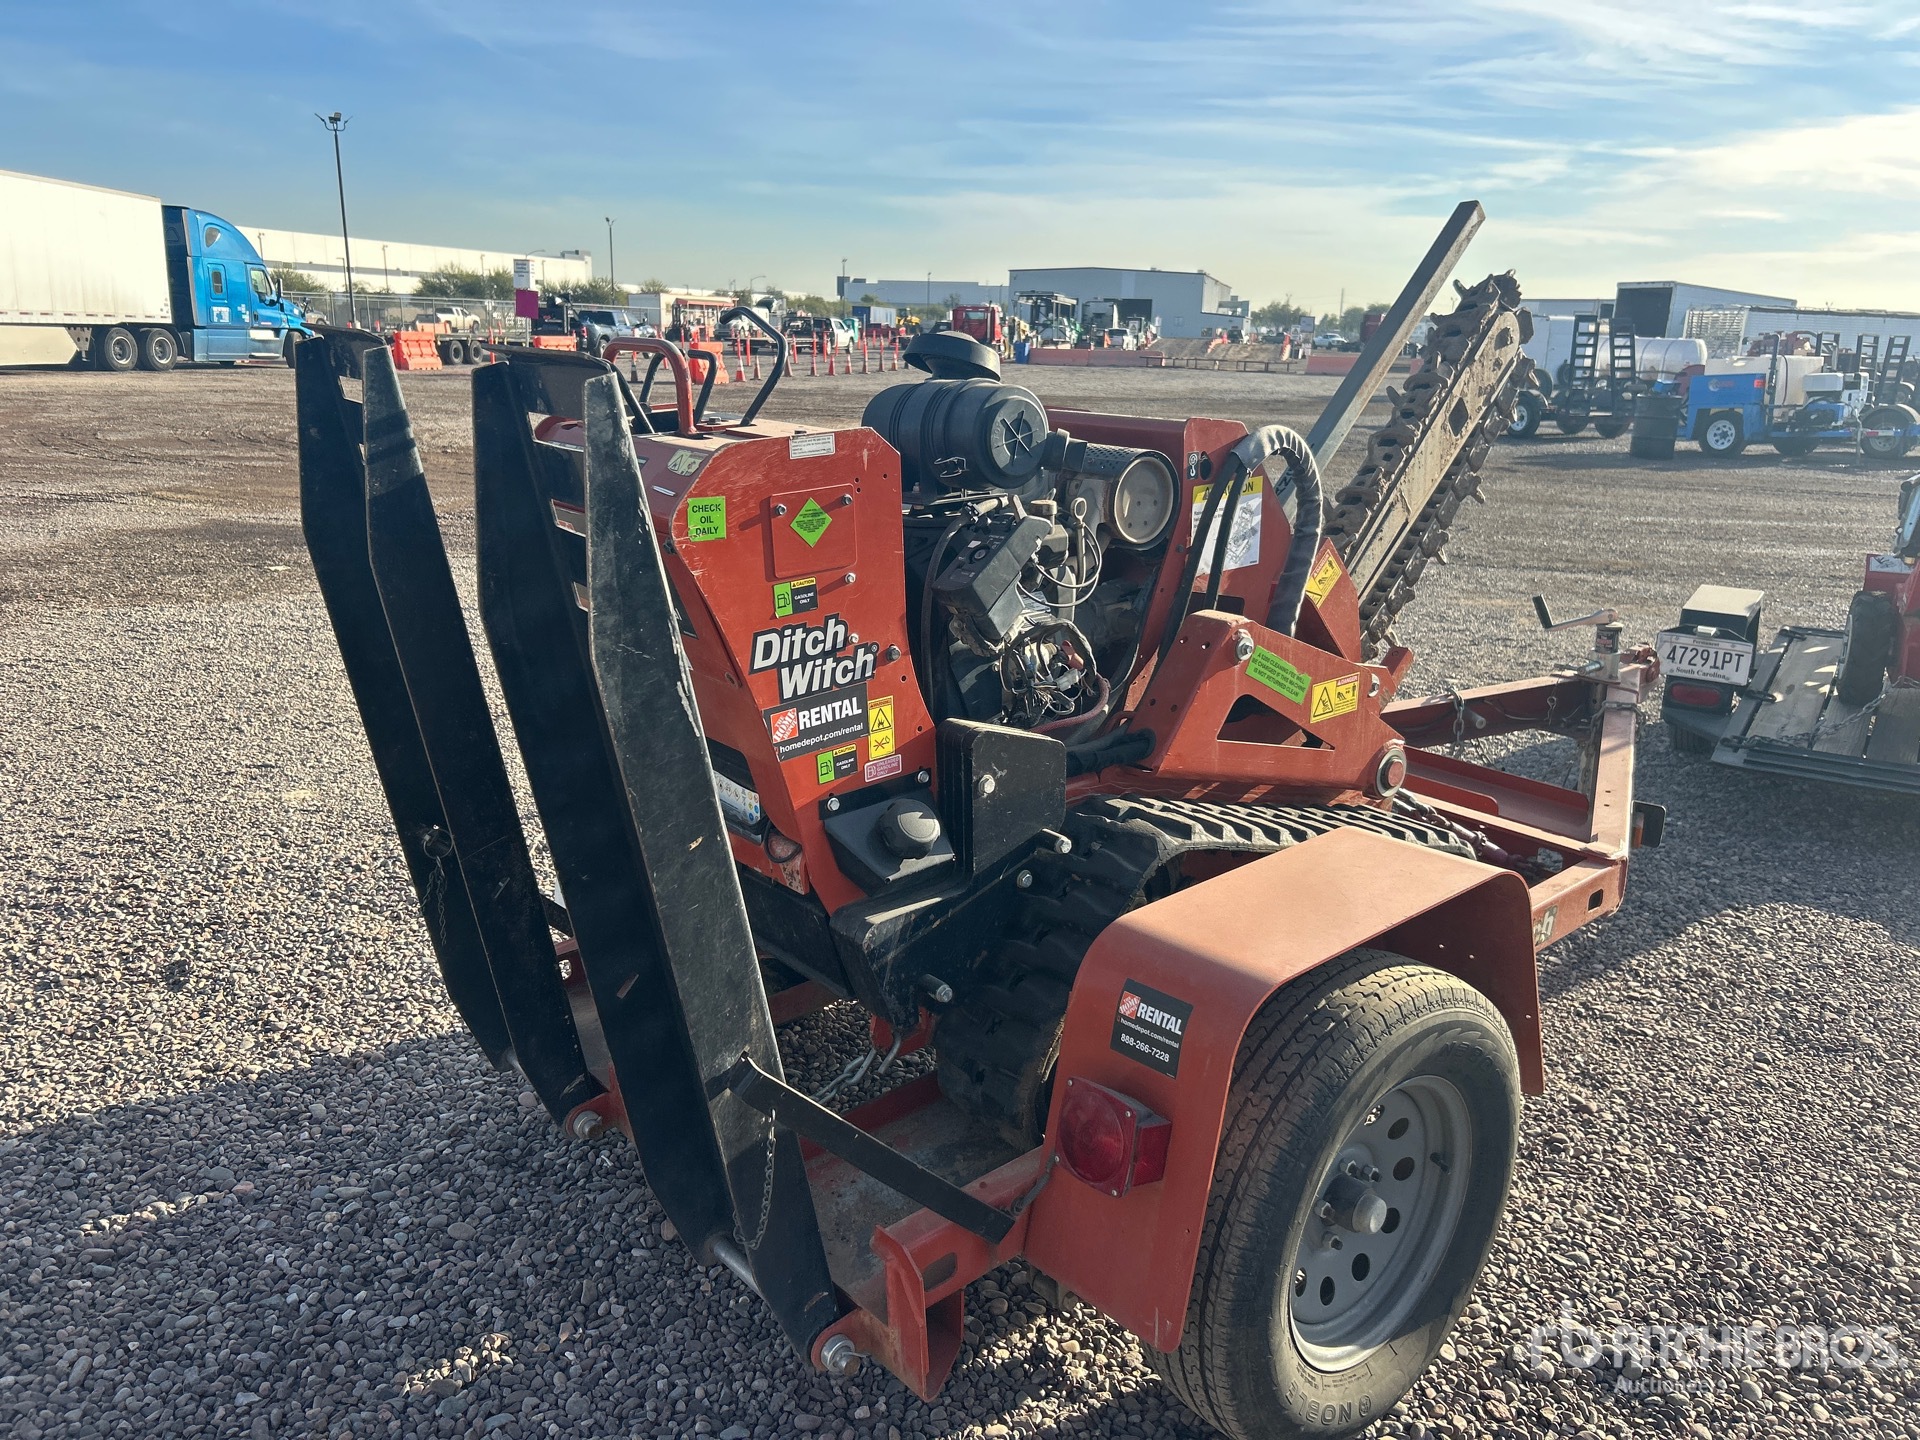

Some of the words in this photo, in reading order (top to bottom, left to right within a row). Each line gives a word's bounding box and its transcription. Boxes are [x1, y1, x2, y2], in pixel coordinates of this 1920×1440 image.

[692, 503, 721, 513] CHECK
[700, 516, 714, 524] OIL
[696, 527, 719, 535] DAILY
[797, 579, 814, 587] CAUTION
[794, 592, 814, 600] GASOLINE
[754, 618, 846, 670] Ditch
[1666, 645, 1744, 672] 47291PT
[1268, 659, 1289, 673] CLEANING
[1675, 666, 1695, 675] South
[1696, 670, 1726, 680] Carolina
[1256, 661, 1277, 675] CHARGED
[1279, 674, 1289, 682] THIS
[1288, 679, 1306, 692] MACHINE
[1265, 674, 1287, 689] RETURNED
[1285, 686, 1299, 696] CLEAN
[798, 697, 862, 730] RENTAL
[779, 722, 864, 754] homedepot.com/rental
[838, 746, 855, 754] CAUTION
[836, 757, 855, 767] GASOLINE
[877, 757, 900, 767] UNLEADED
[877, 762, 898, 772] GASOLINE
[877, 769, 888, 777] ONLY
[1137, 1002, 1182, 1036] RENTAL
[1120, 1017, 1180, 1049] homedepot.com/rental
[1120, 1033, 1170, 1063] 888-266-7228
